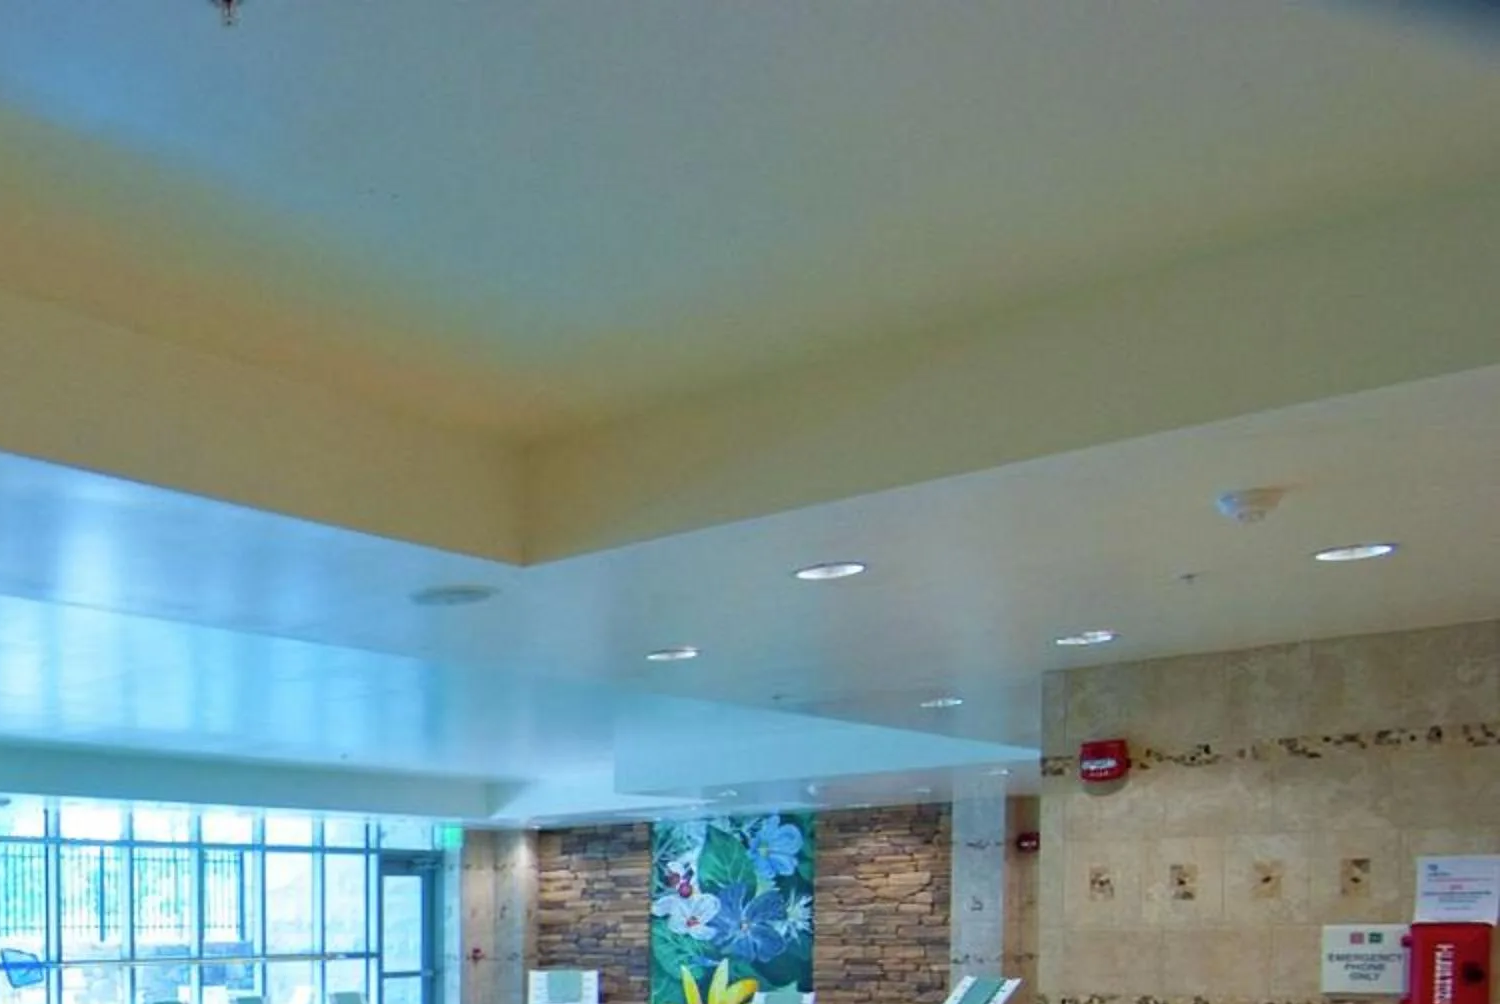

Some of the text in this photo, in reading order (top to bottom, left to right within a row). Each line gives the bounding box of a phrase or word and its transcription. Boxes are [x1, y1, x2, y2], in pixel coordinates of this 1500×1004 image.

[1328, 952, 1402, 963] EMERGENCY
[1344, 963, 1386, 972] PHONE
[1348, 971, 1381, 981] ONLY
